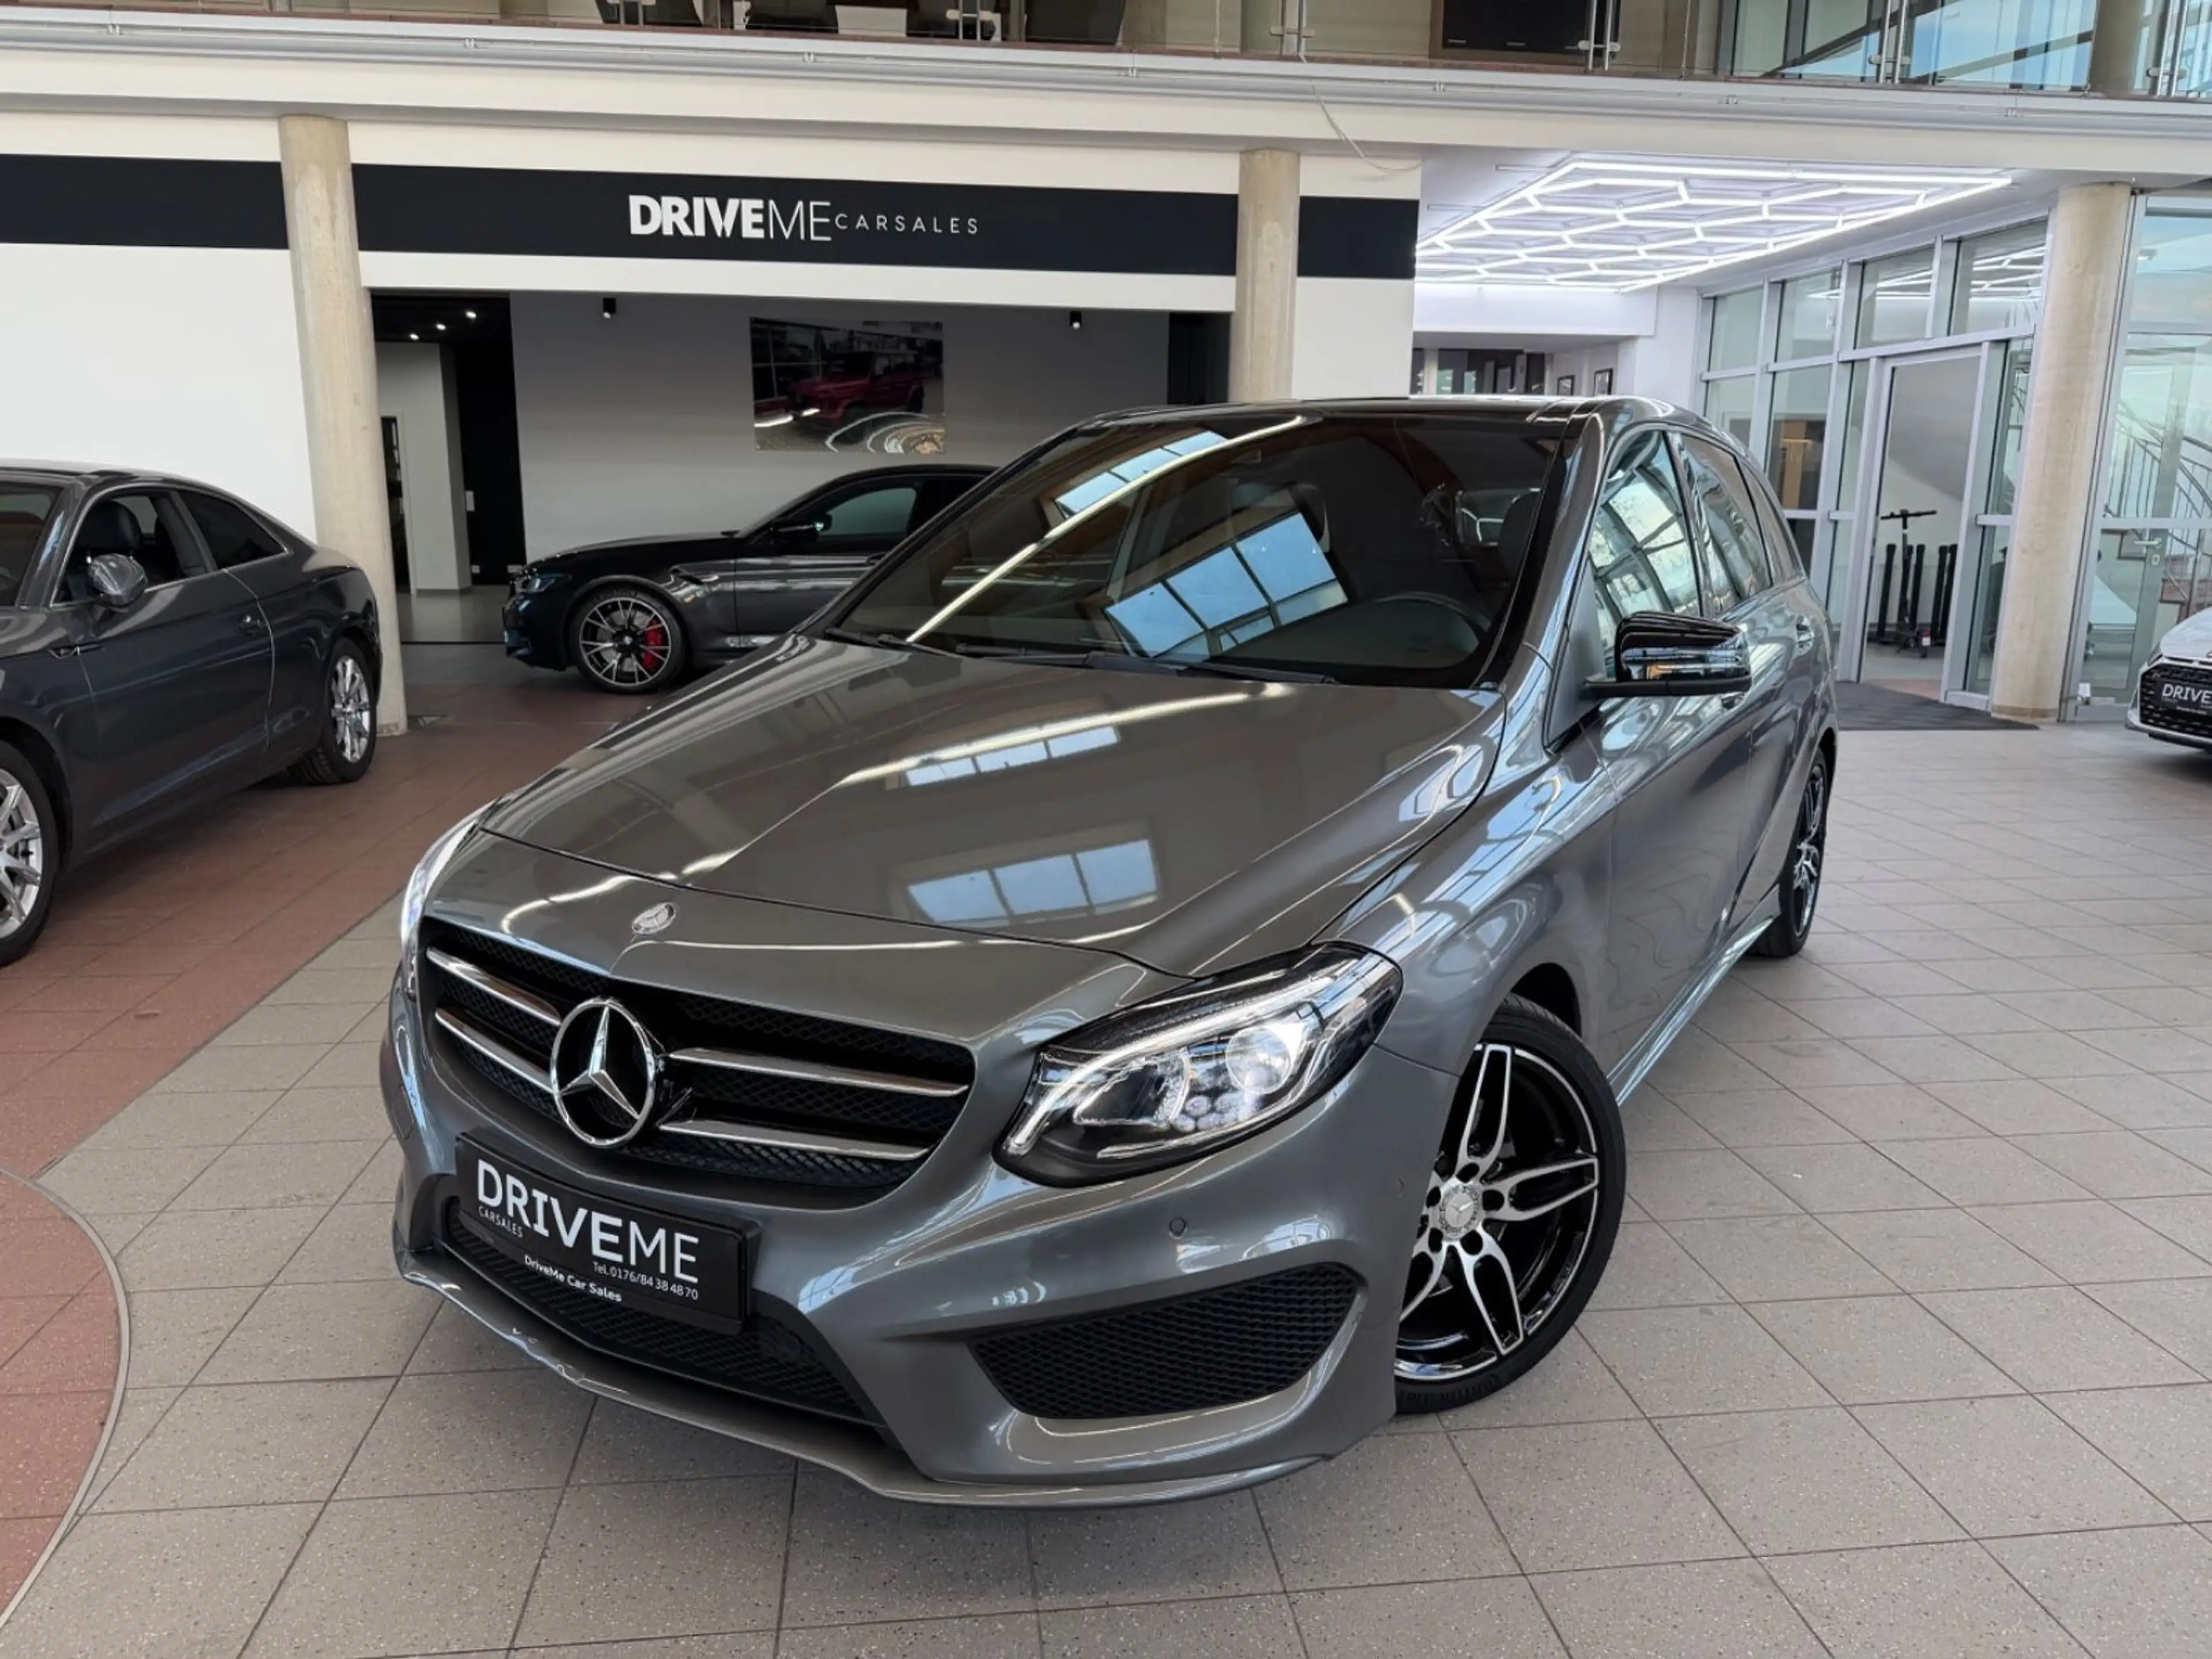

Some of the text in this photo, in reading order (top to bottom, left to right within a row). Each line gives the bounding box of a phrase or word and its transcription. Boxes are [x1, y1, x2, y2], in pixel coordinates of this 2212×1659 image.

[835, 213, 978, 234] CARSALES
[478, 1158, 699, 1283] DRIVEME
[478, 1205, 523, 1238] CARSALES
[524, 1254, 622, 1302] DriveMe Car Sales
